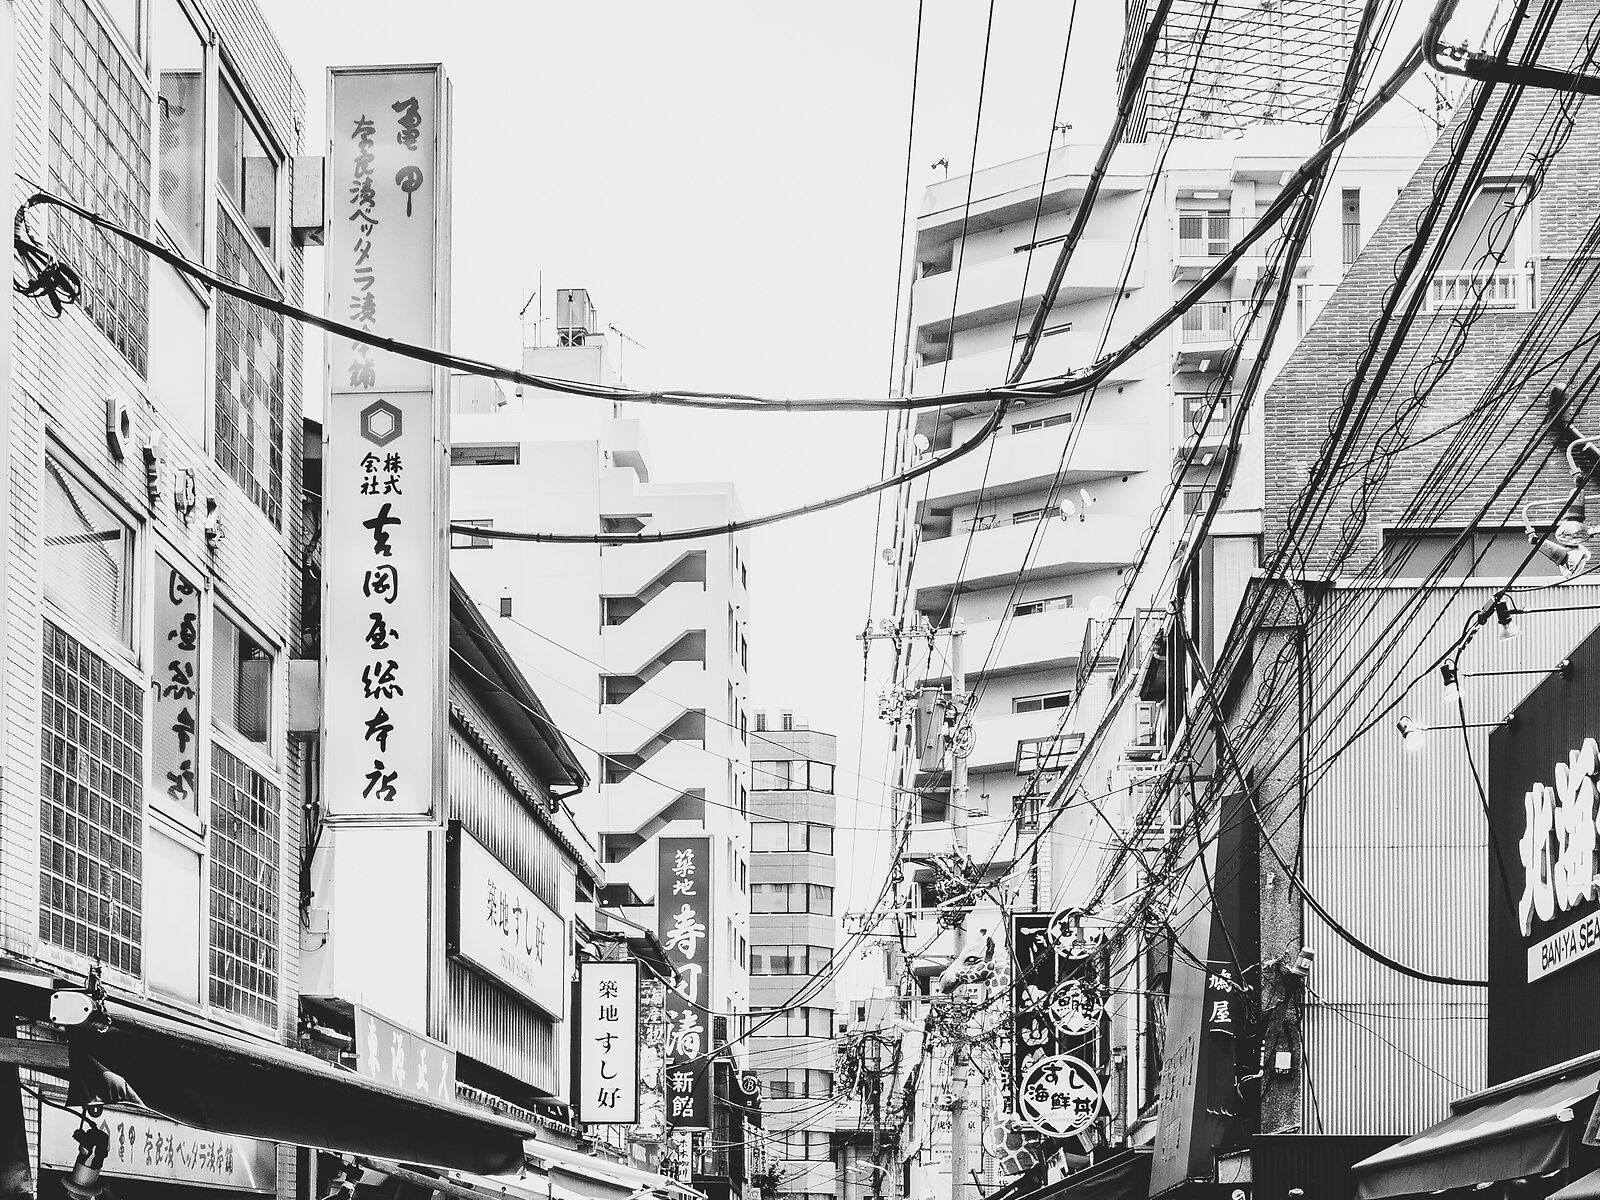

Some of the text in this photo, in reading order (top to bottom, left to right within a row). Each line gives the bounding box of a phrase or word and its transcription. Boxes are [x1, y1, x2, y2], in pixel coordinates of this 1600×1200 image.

[360, 452, 381, 496] 会社
[382, 452, 403, 496] 株式
[361, 502, 404, 802] 吉岡屋総本店
[1518, 737, 1600, 937] 北海
[672, 848, 697, 896] 築地
[486, 878, 546, 967] 築地すし好
[1541, 929, 1578, 971] BAN-YA
[595, 981, 621, 1109] 築地すし好
[672, 1070, 695, 1118] 新館
[1041, 1063, 1085, 1089] すし
